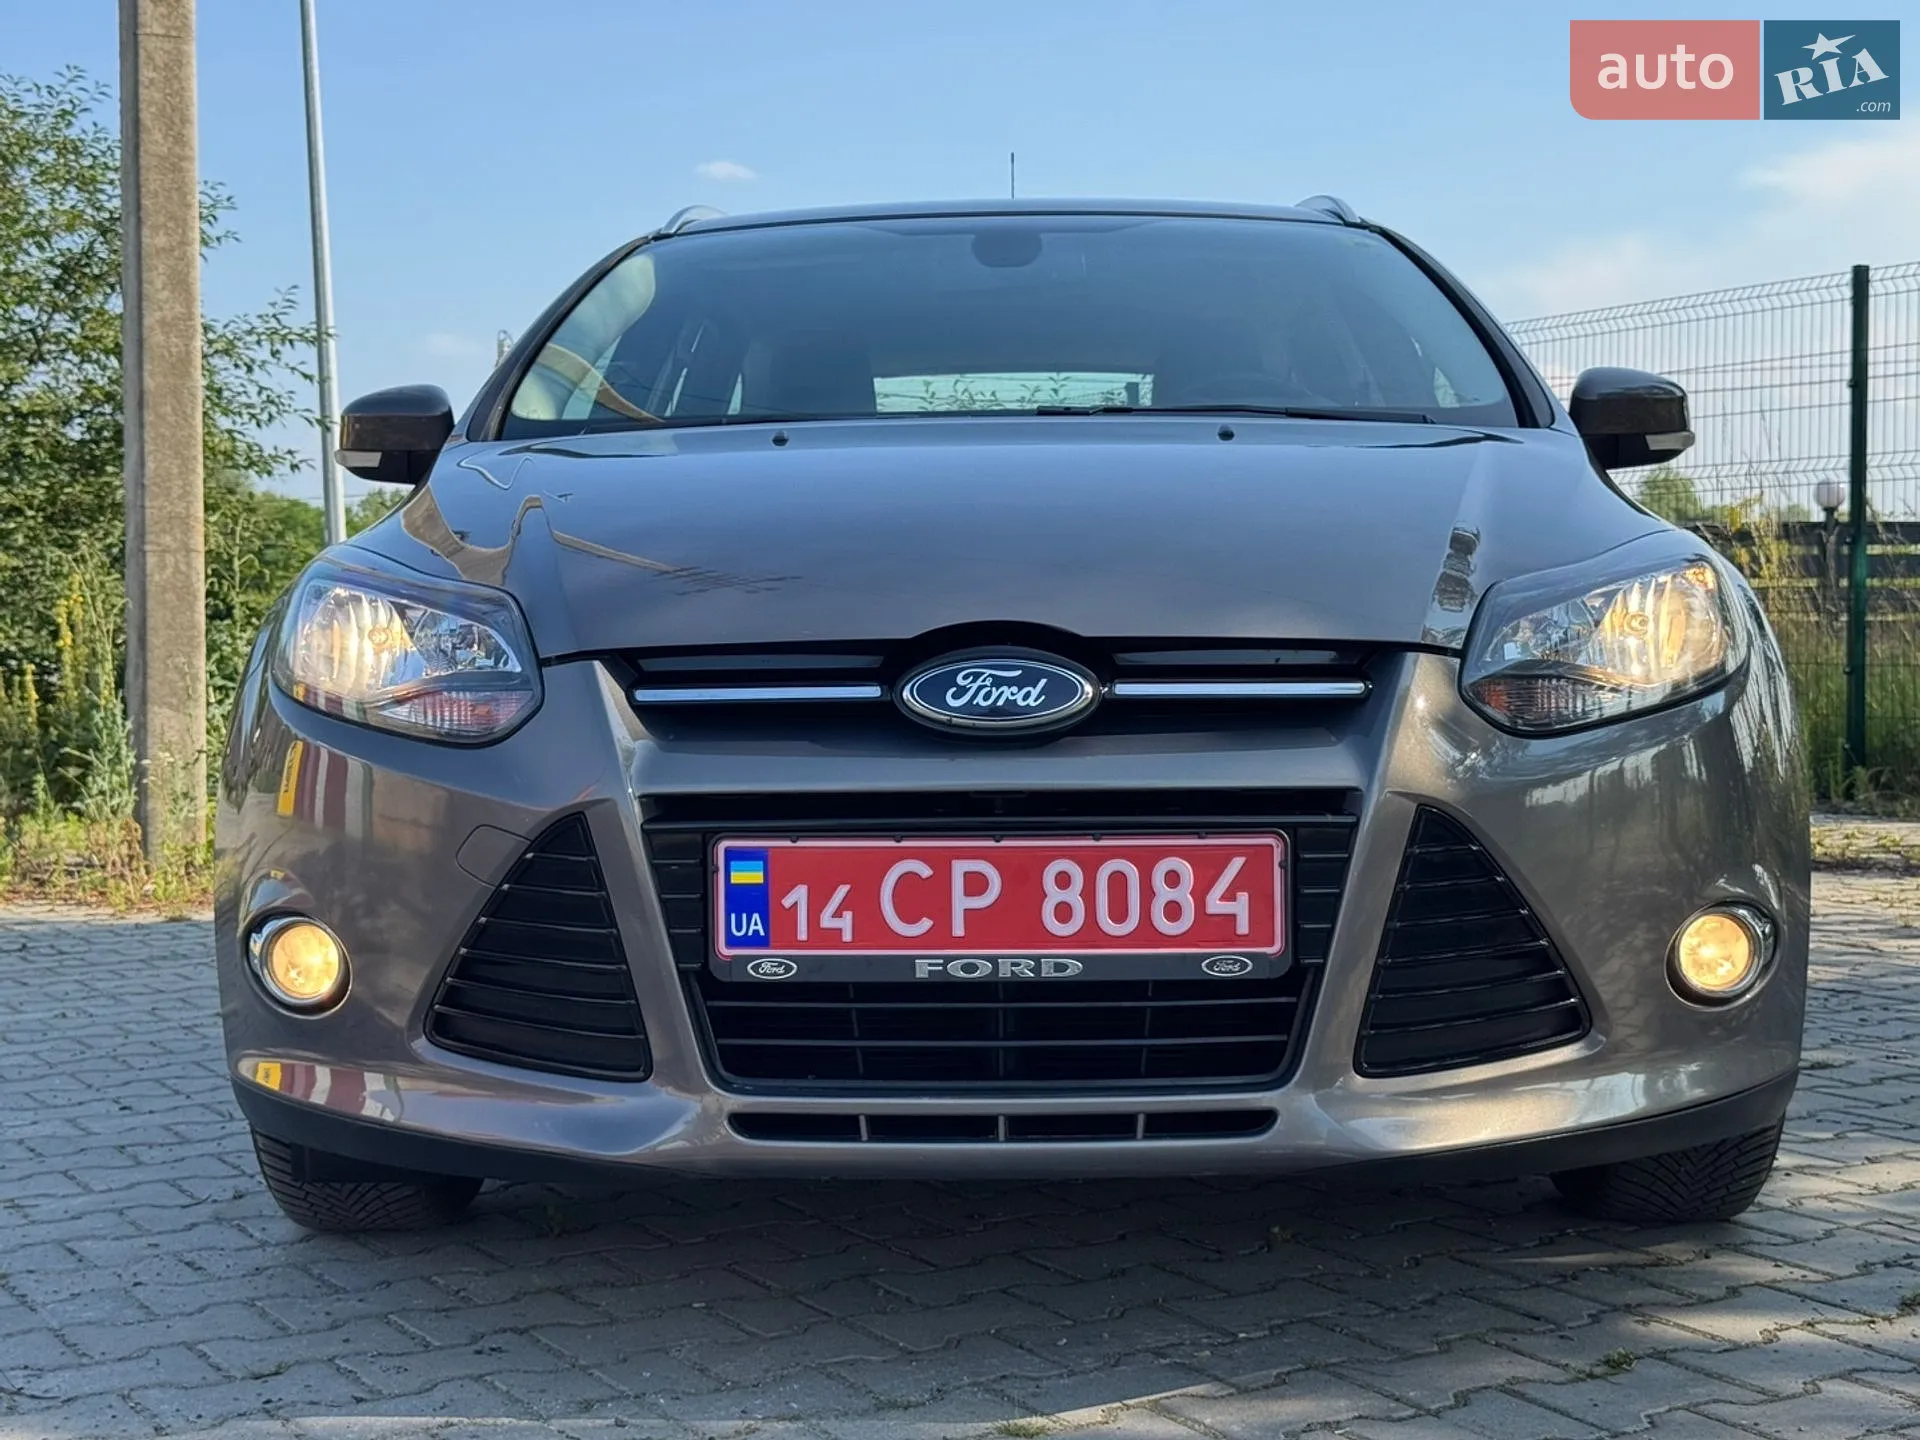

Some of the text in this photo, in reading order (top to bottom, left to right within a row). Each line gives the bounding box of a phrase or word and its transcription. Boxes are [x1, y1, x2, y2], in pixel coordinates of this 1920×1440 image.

[945, 668, 1047, 707] Ford
[780, 856, 1249, 943] 14 CP 8084
[730, 912, 766, 937] UA
[758, 961, 786, 974] Ford
[914, 958, 1084, 979] FORD
[1213, 959, 1241, 972] Ford
